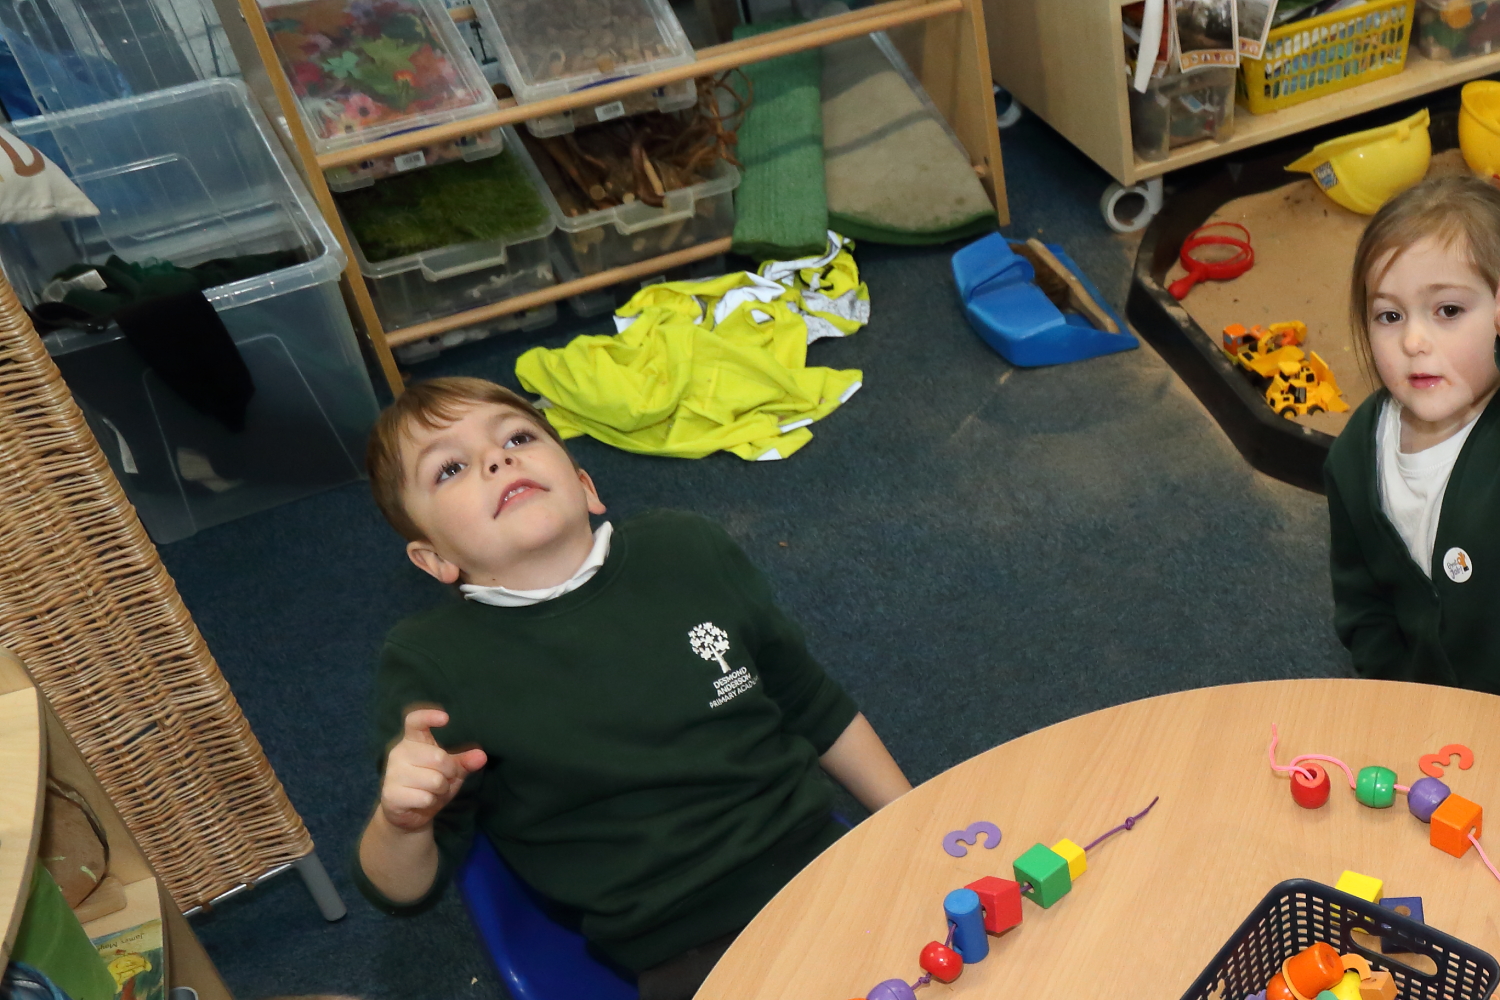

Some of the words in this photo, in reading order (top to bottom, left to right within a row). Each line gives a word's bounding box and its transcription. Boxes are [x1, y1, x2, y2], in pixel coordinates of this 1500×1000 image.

[709, 691, 740, 709] PRIMARY
[737, 675, 759, 695] ACAD
[713, 666, 748, 689] DESMOND
[717, 673, 751, 697] ANDERSON
[1419, 744, 1474, 777] 3
[943, 821, 1002, 857] 3
